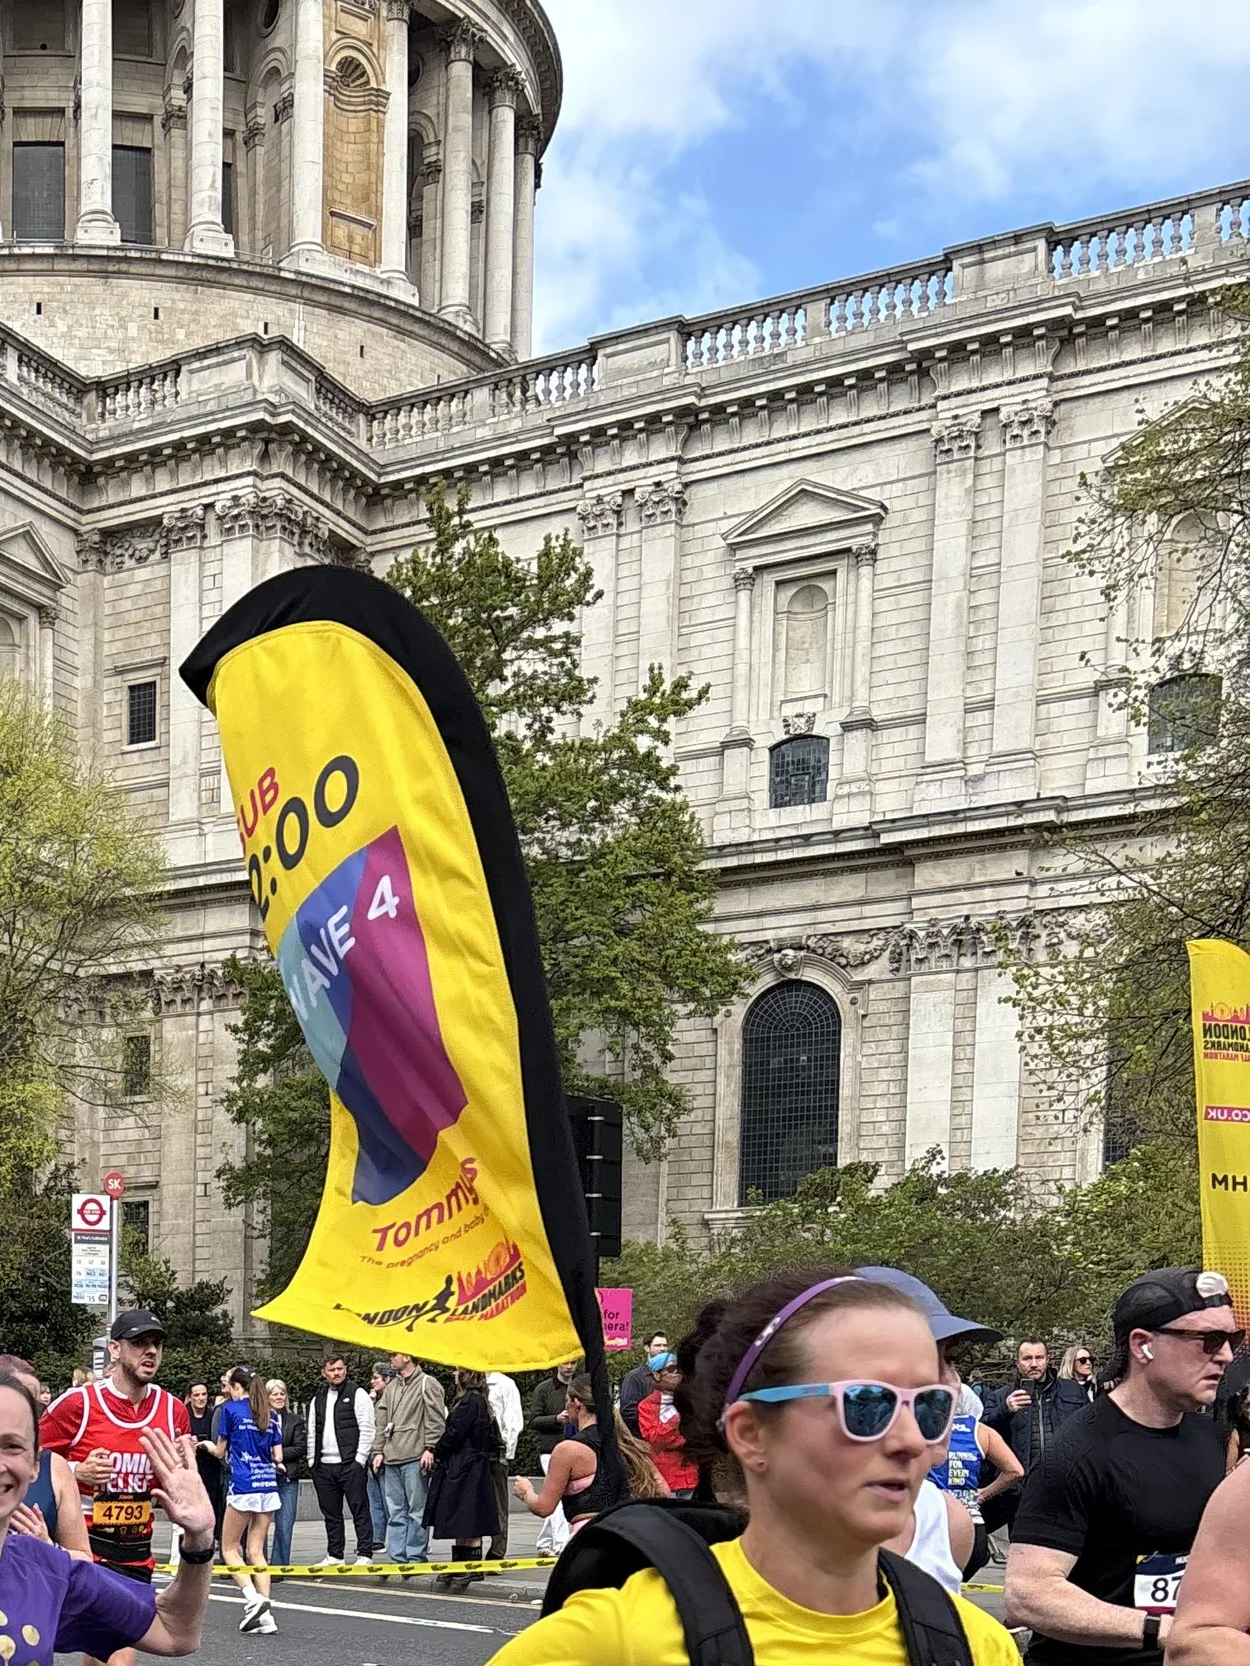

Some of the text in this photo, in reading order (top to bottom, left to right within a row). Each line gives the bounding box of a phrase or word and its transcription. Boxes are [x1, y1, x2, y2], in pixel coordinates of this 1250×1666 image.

[367, 874, 400, 921] 4
[108, 1178, 121, 1190] SK
[360, 1255, 383, 1266] The
[386, 1240, 440, 1269] pregnancy
[442, 1227, 462, 1245] and
[604, 1309, 620, 1320] for
[604, 1322, 629, 1331] era!
[102, 1505, 144, 1521] 4793
